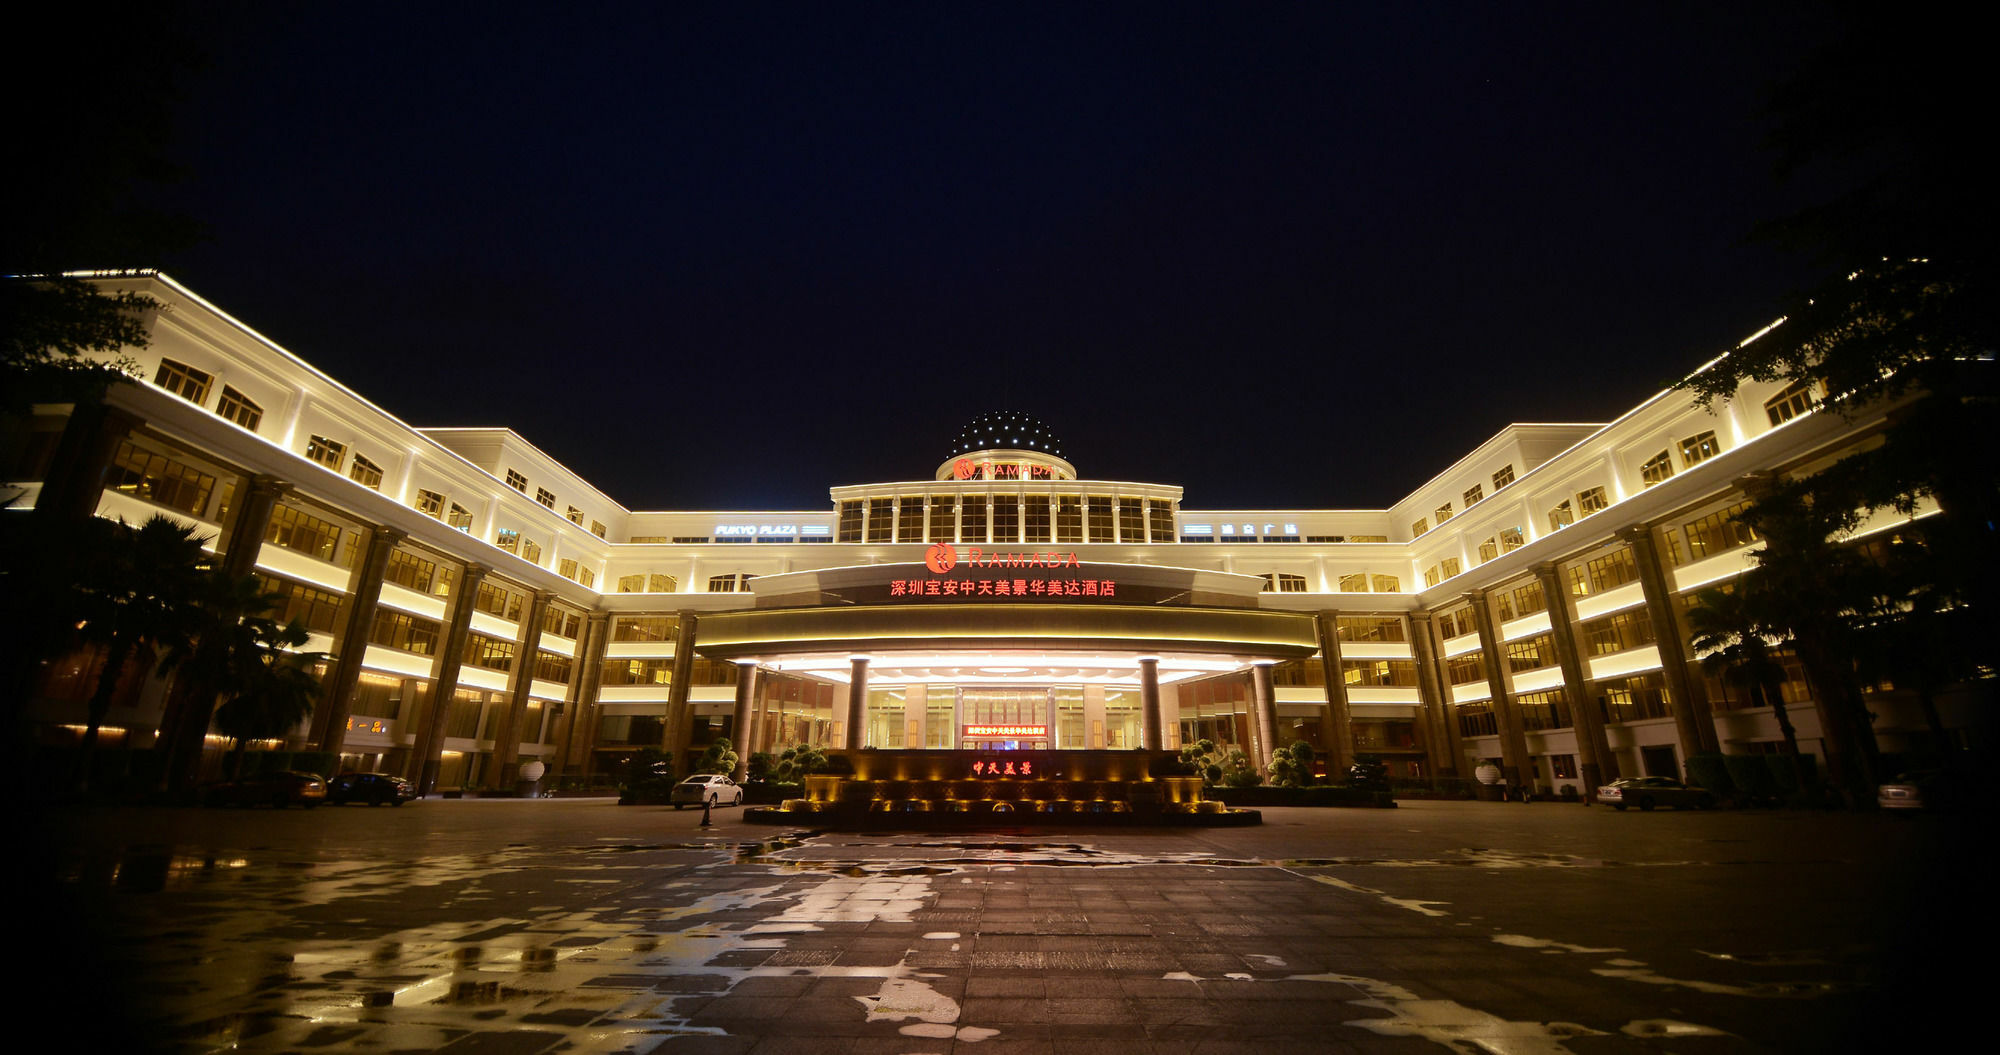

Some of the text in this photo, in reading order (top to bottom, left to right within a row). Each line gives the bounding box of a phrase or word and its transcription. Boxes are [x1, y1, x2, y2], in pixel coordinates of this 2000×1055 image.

[982, 462, 1056, 475] RAMADA
[759, 525, 797, 535] PLAZA
[968, 547, 1081, 569] RAMADA
[890, 579, 1116, 597] 深圳宝安中天美景华美达酒店
[973, 760, 1032, 776] 中天美景
